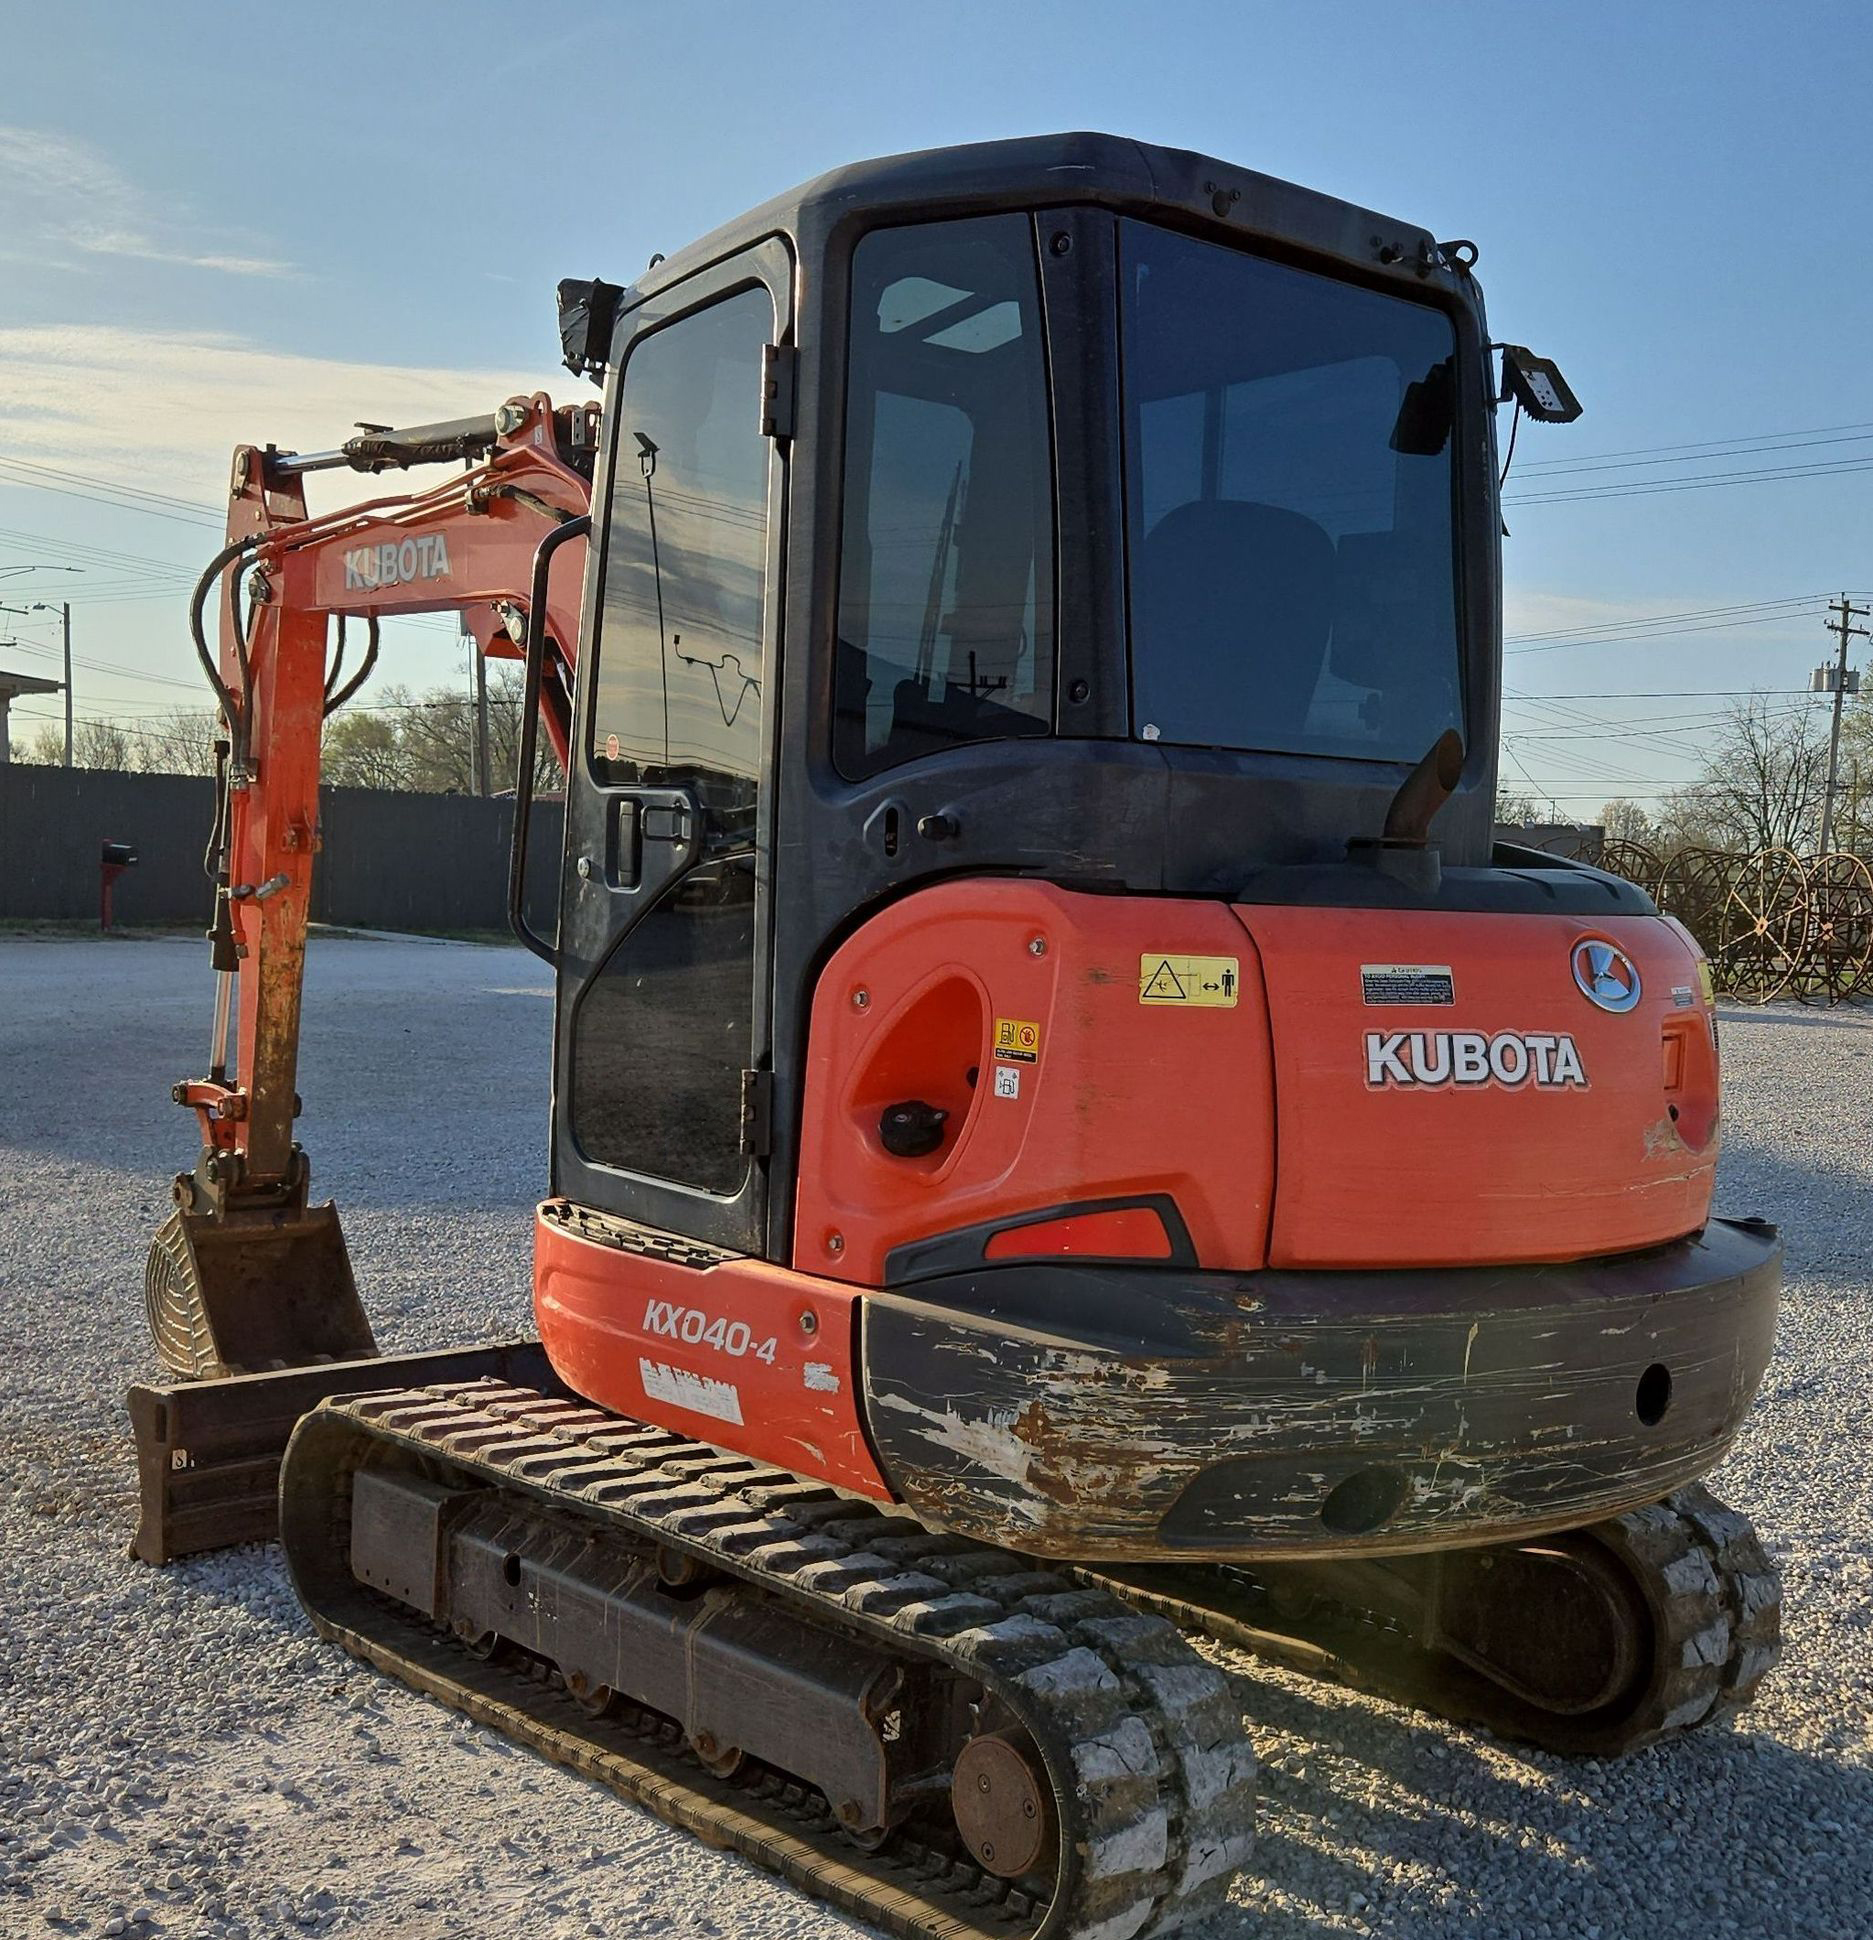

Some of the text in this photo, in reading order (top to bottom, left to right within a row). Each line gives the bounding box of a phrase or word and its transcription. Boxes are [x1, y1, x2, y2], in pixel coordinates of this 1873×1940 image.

[345, 533, 450, 590] KUBOTA
[1365, 1031, 1588, 1086] KUBOTA
[642, 1298, 778, 1366] KX040-4
